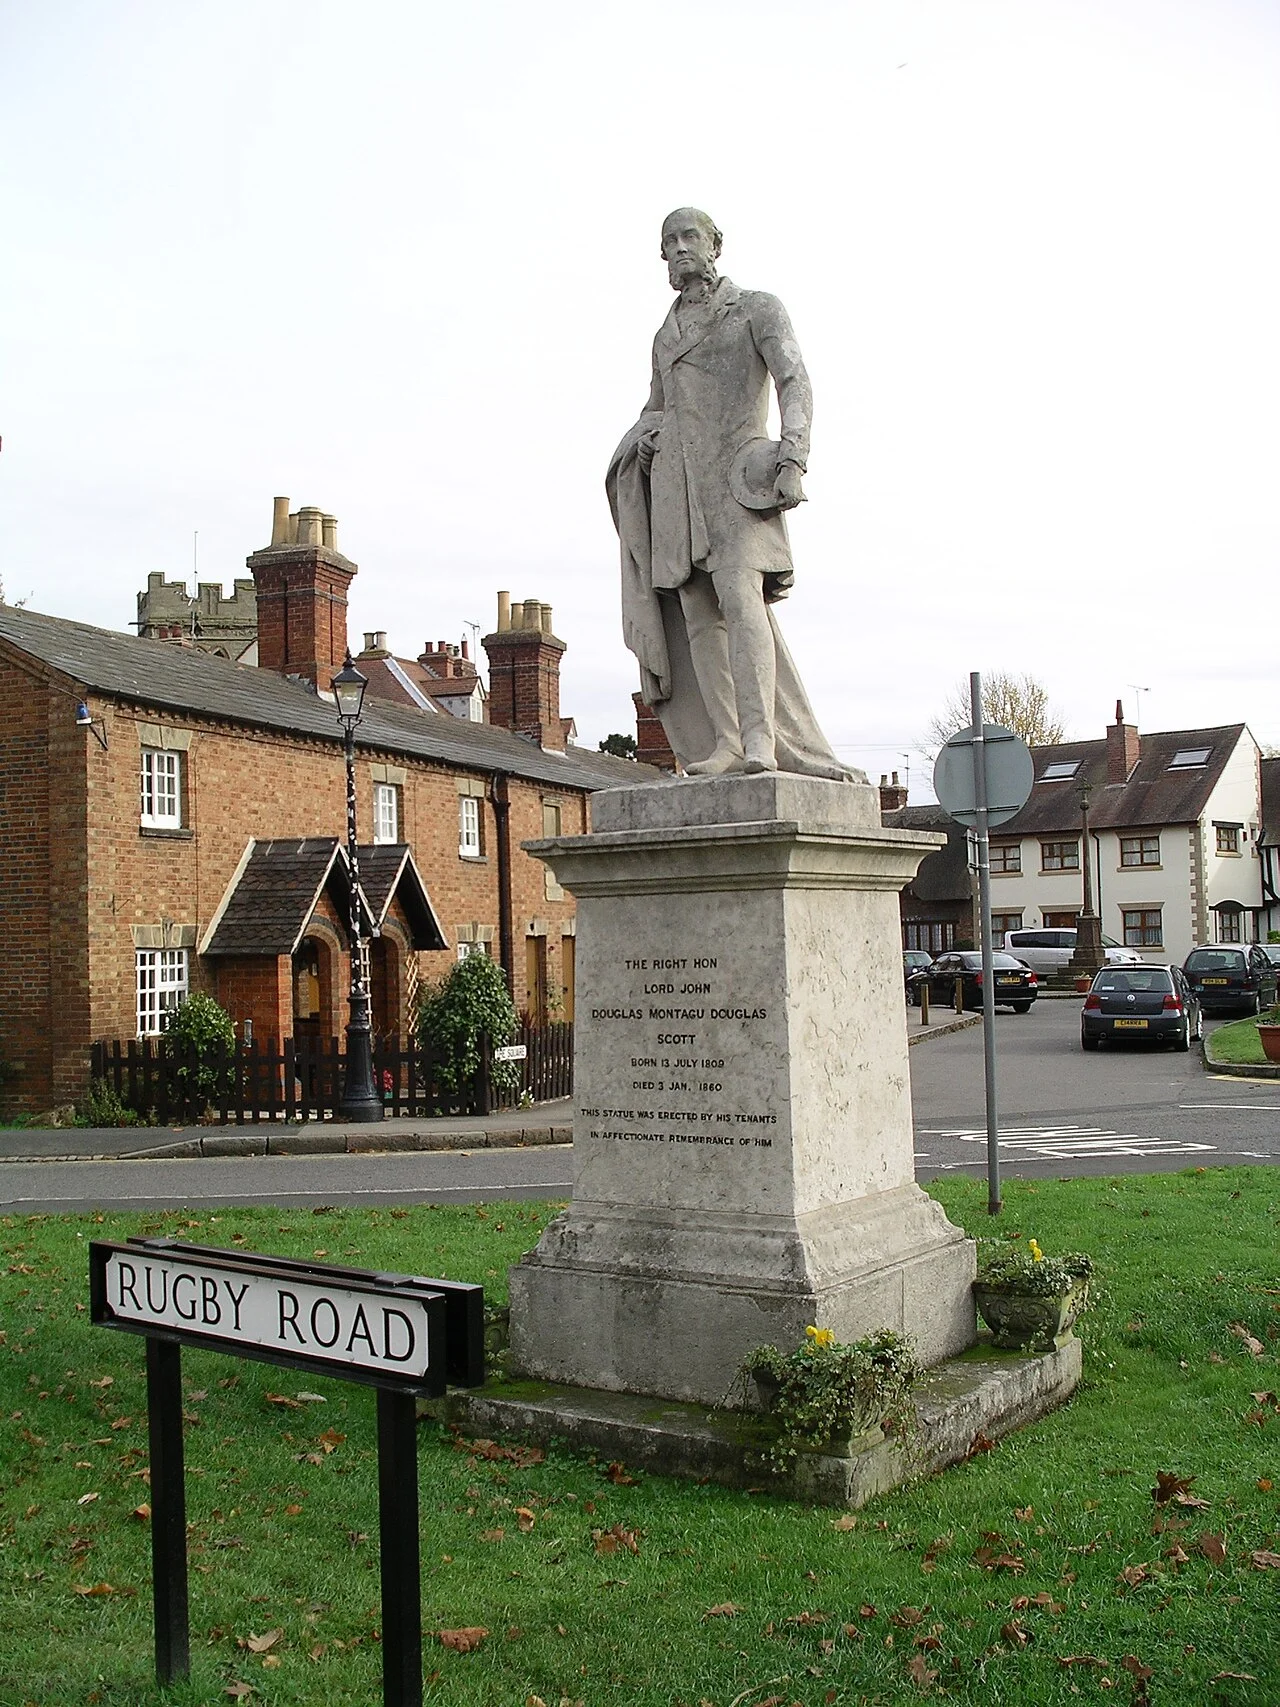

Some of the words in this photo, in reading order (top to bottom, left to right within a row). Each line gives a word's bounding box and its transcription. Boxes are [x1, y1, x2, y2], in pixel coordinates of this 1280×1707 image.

[624, 960, 648, 970] THE
[653, 959, 688, 970] RIGHT
[693, 958, 718, 969] HON
[644, 984, 675, 994] LORD
[680, 983, 711, 994] JOHN
[591, 1008, 643, 1020] DOUGLAS
[648, 1008, 705, 1020] MONTAGU
[710, 1008, 767, 1020] DOUGLAS
[657, 1034, 696, 1045] SCOTT
[507, 1047, 525, 1057] SQUARE
[631, 1058, 657, 1068] BORN
[660, 1058, 670, 1068] 13
[673, 1059, 698, 1068] JULY
[701, 1059, 726, 1069] 1809
[632, 1081, 655, 1091] DIED
[658, 1082, 664, 1091] 3
[698, 1082, 723, 1092] 1860
[581, 1108, 601, 1118] THIS
[603, 1109, 635, 1119] STATUE
[637, 1110, 655, 1120] WAS
[658, 1111, 698, 1121] ERECTED
[700, 1112, 714, 1122] BY
[716, 1113, 731, 1123] HIS
[735, 1114, 778, 1124] TENANTS
[590, 1131, 600, 1139] IN
[602, 1131, 665, 1143] AFFECTIONATE
[669, 1134, 735, 1146] REMEMBRANCE
[739, 1137, 751, 1146] OF
[754, 1138, 772, 1147] HIM
[117, 1262, 250, 1331] RUGBY
[277, 1289, 416, 1362] ROAD
